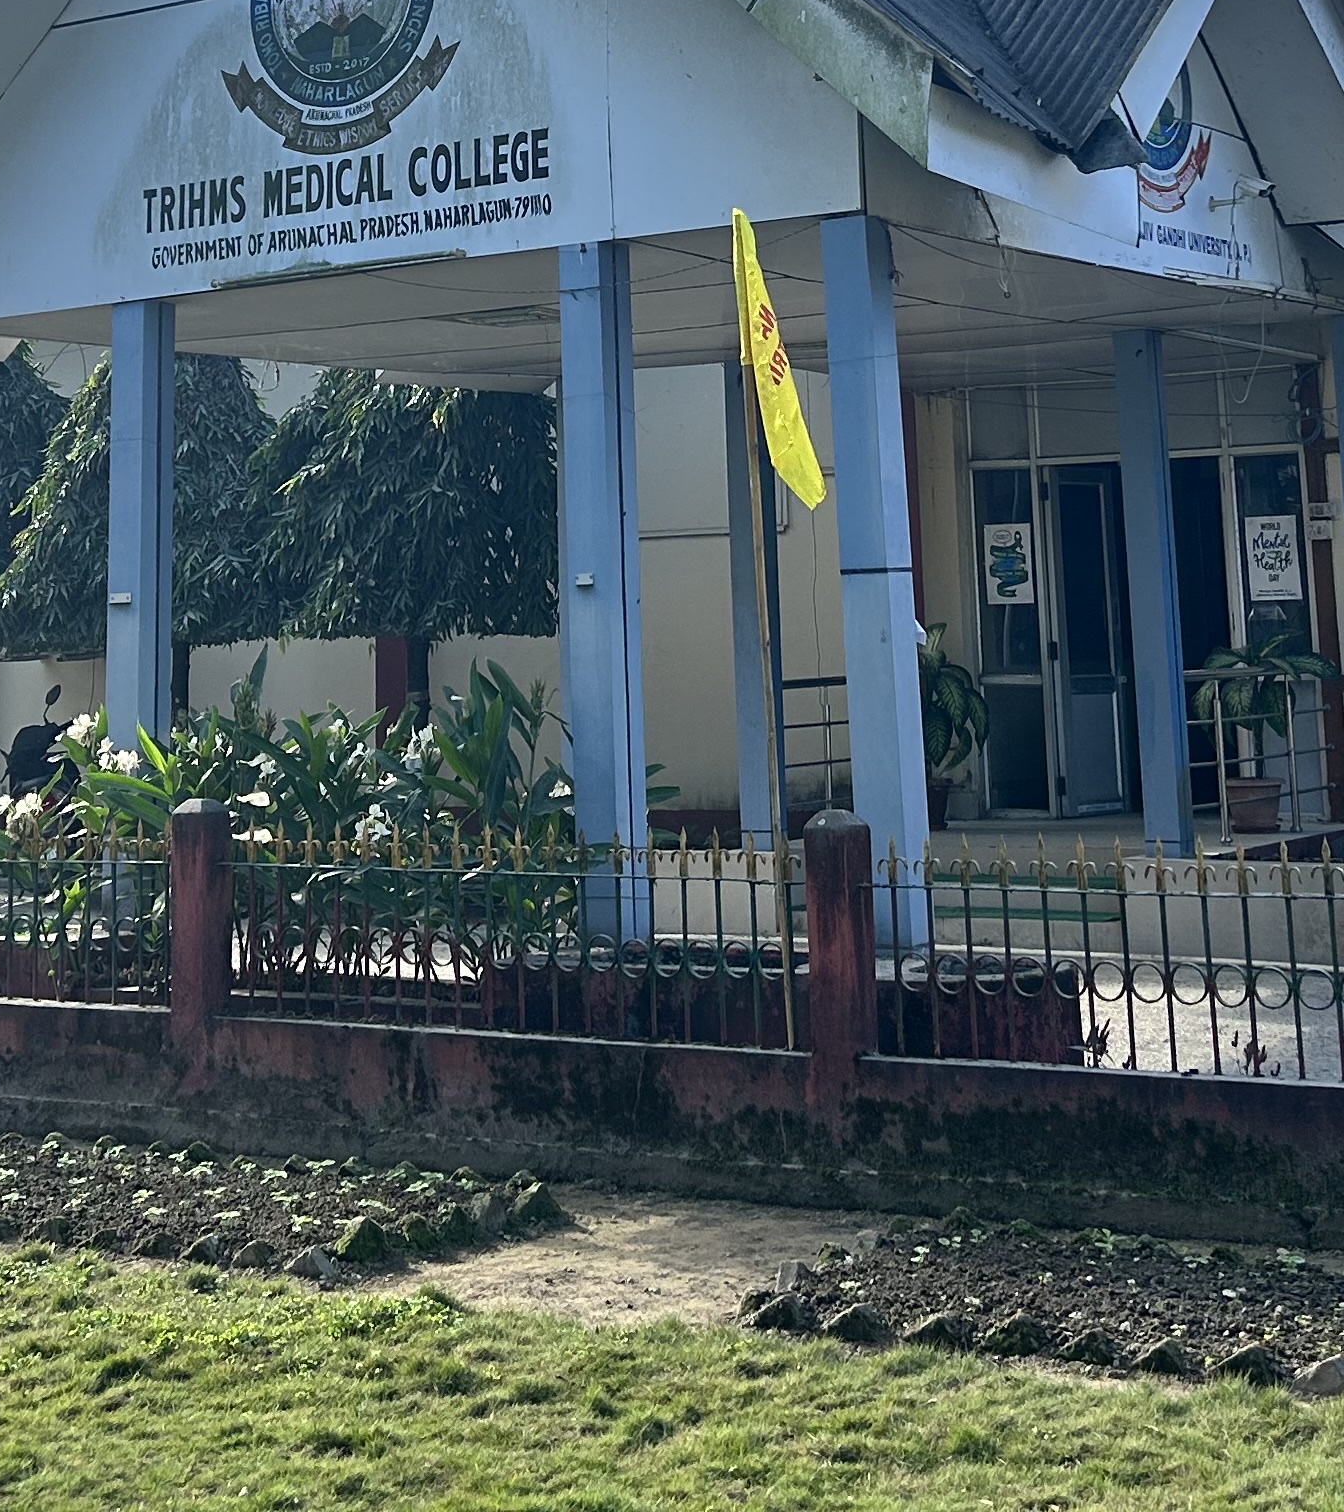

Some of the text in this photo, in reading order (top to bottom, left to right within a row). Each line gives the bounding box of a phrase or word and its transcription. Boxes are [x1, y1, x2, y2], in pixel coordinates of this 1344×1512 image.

[259, 32, 283, 75] TOMO
[309, 62, 332, 74] ESTD
[343, 56, 370, 70] 2017
[290, 65, 386, 102] NAHARLAGUN
[297, 129, 337, 148] ETHICS
[143, 127, 550, 234] TRIHMS MEDICAL COLLEGE
[151, 235, 242, 270] GOVERNMENT
[248, 232, 265, 257] OF
[267, 219, 357, 255] ARUNACHAL
[1157, 224, 1187, 249] GANDHI
[1260, 522, 1281, 531] WORLD
[1252, 531, 1291, 552] Mental
[1252, 550, 1293, 573] Health
[1268, 573, 1280, 583] DAY
